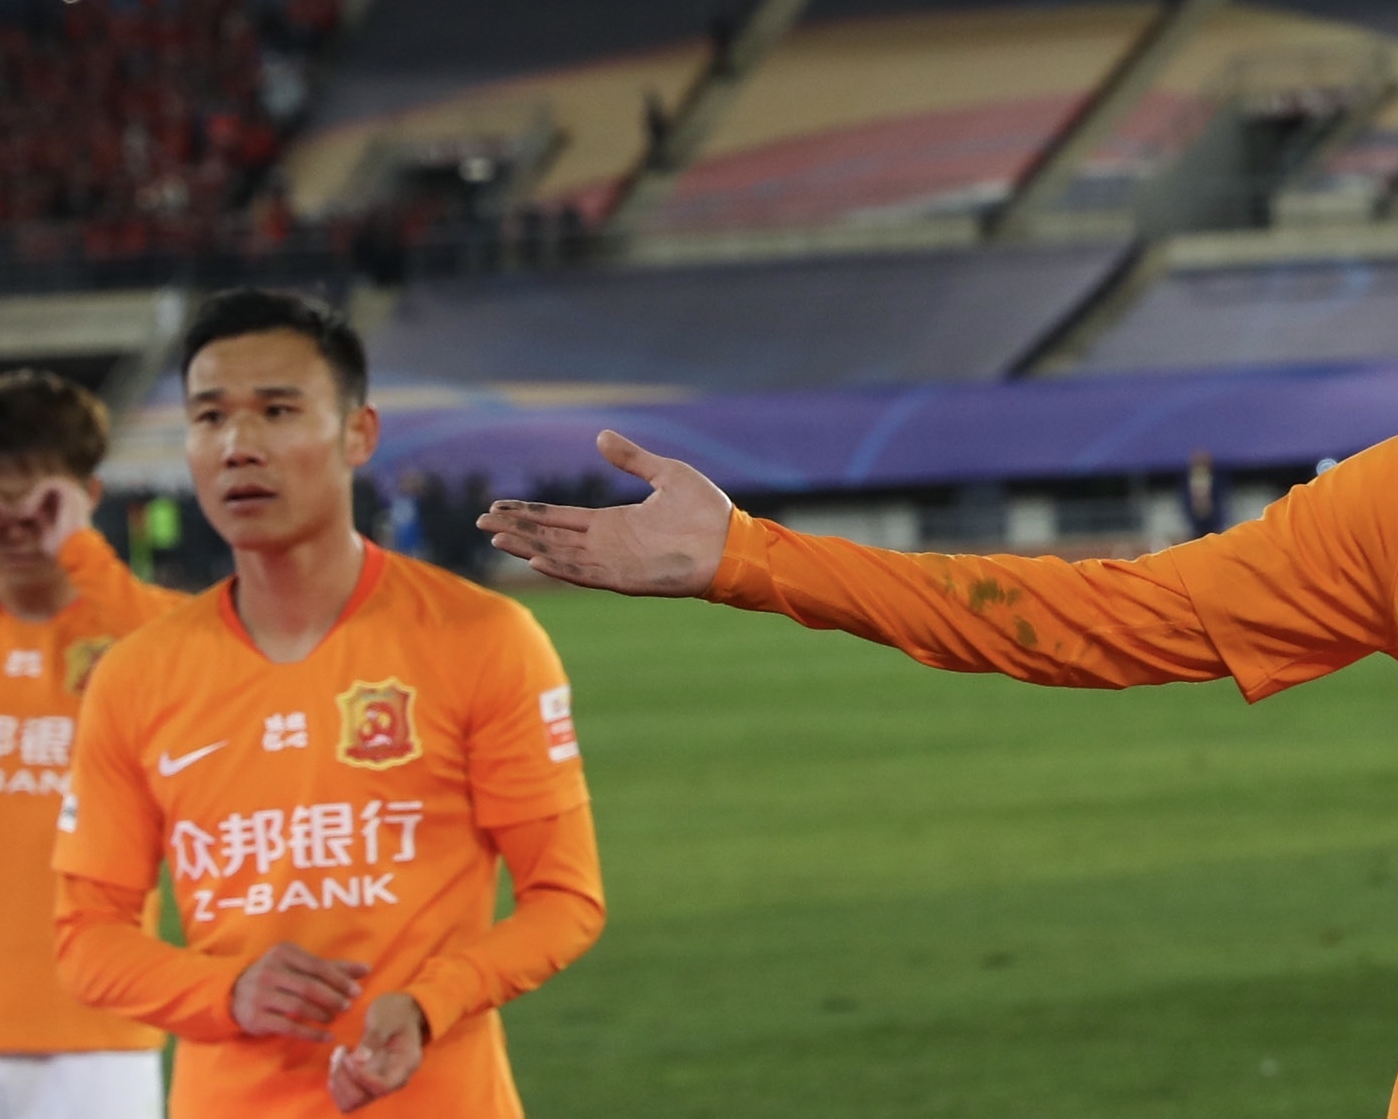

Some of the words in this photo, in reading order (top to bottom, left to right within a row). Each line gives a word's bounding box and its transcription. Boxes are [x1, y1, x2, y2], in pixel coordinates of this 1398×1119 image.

[170, 800, 424, 882] 众邦银行
[193, 873, 399, 922] Z-BANK
